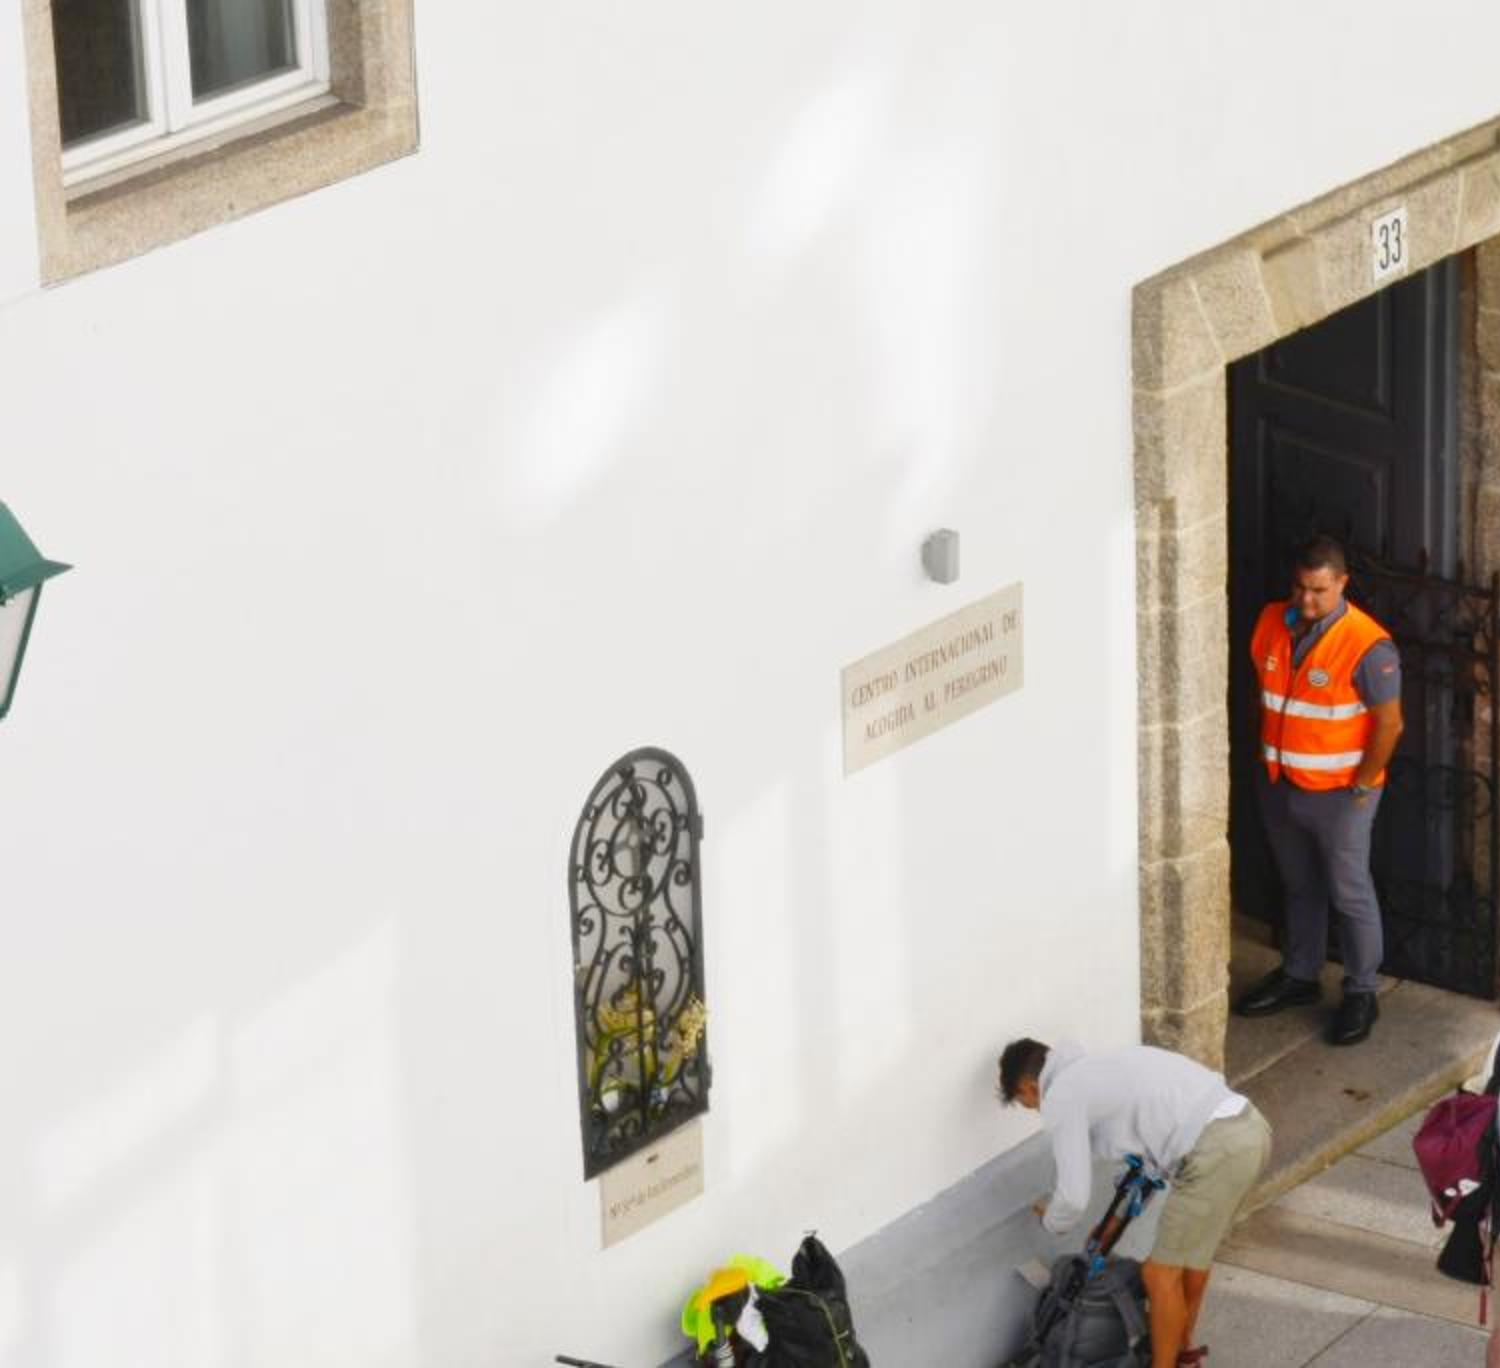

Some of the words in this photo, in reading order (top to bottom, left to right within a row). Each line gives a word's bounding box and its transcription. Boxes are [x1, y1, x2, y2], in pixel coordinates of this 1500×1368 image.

[1379, 217, 1401, 270] 33
[850, 670, 898, 707] CENTRO
[904, 621, 994, 683] INTERNACIONAL
[1002, 608, 1018, 635] DE
[865, 703, 916, 739] ACOGIDA
[924, 690, 936, 712] AL
[943, 655, 1008, 703] PEREGRINO
